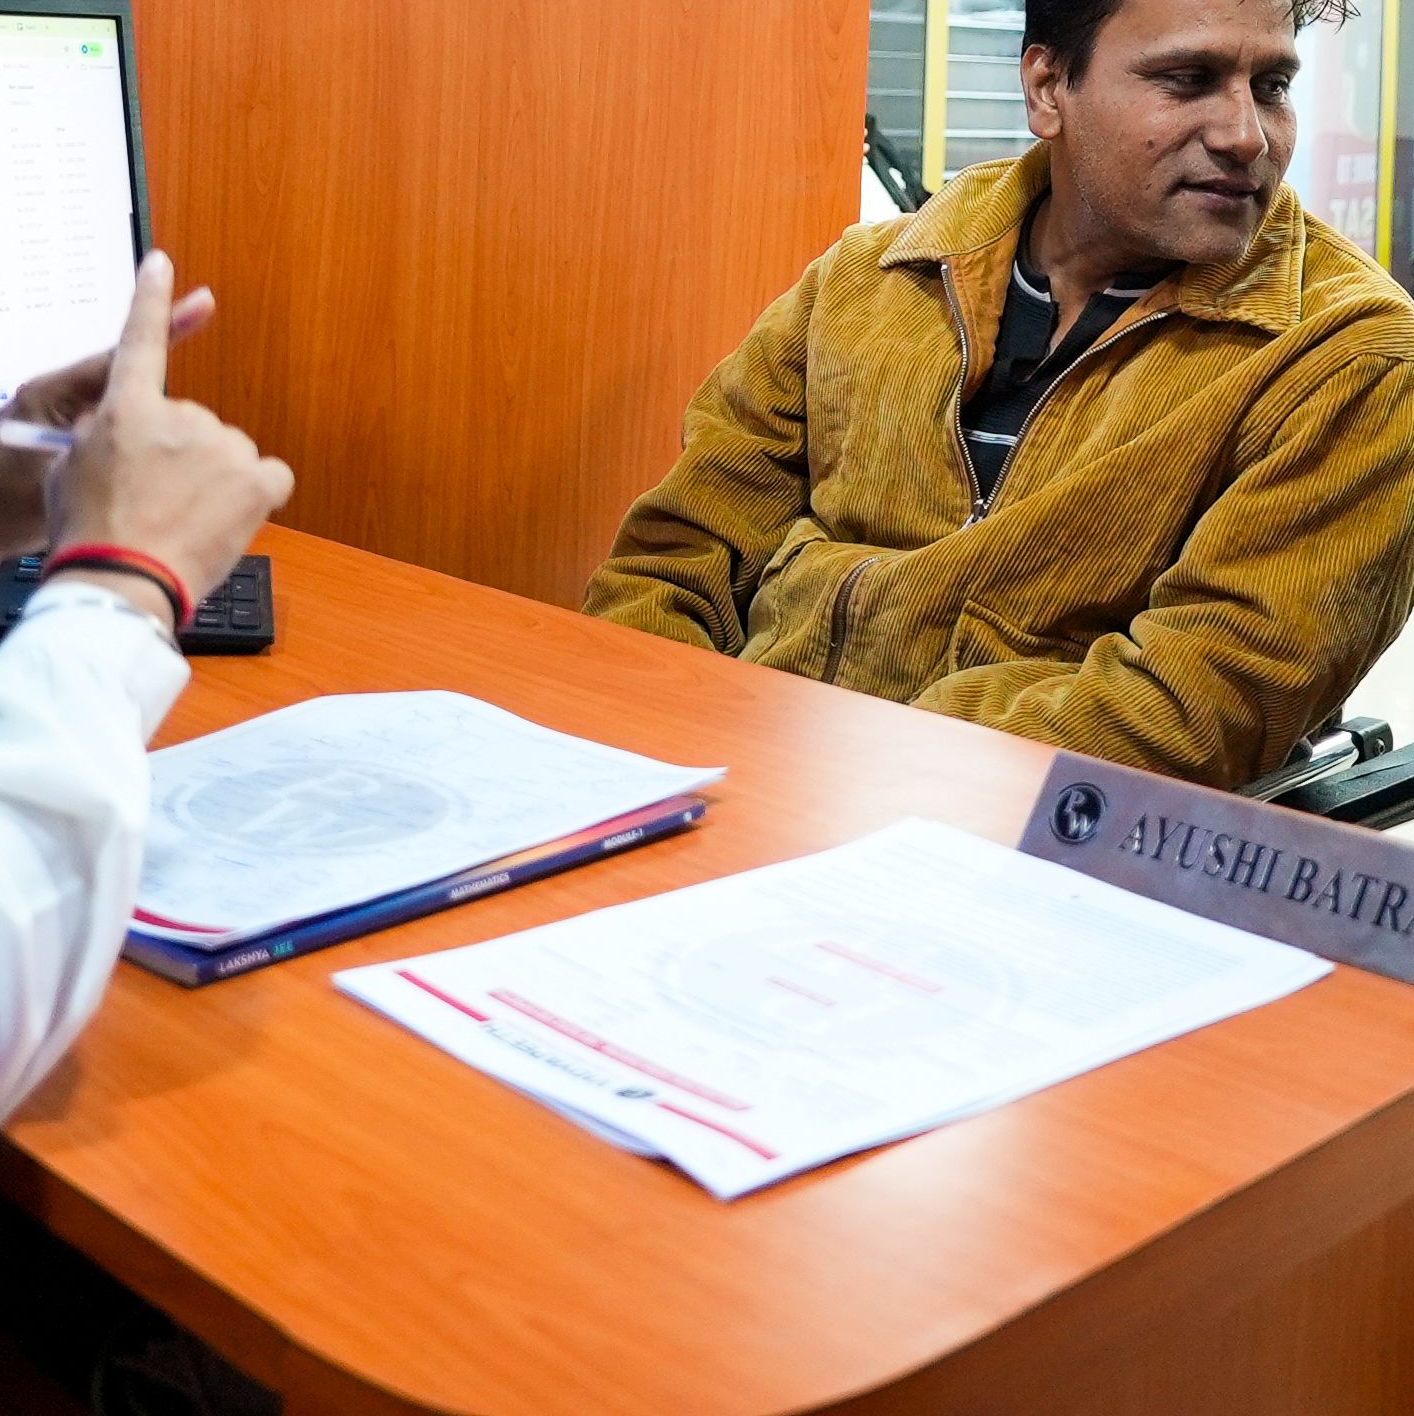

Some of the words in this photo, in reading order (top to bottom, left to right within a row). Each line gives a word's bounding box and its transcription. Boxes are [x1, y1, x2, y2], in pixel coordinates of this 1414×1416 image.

[1118, 811, 1284, 895] AYUSHI
[450, 872, 510, 899] MATHEMATICS
[218, 948, 271, 973] LAKSHYA
